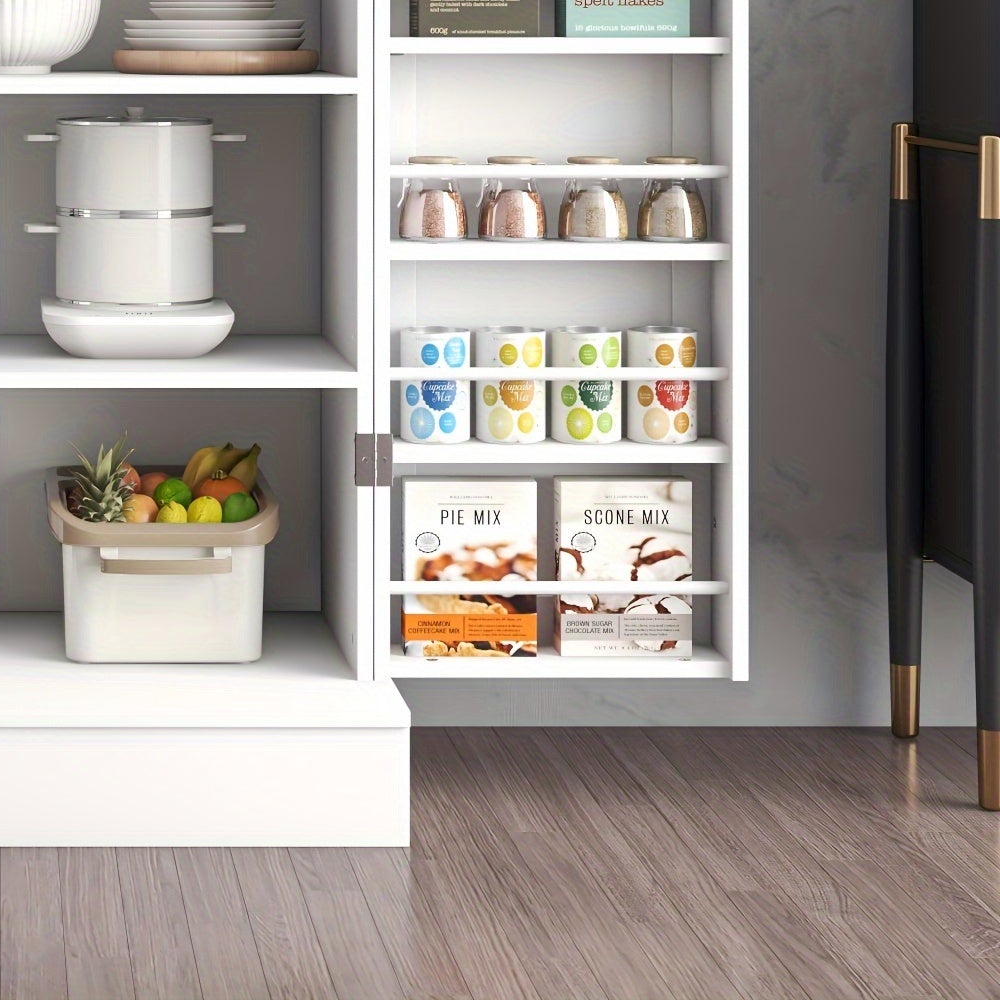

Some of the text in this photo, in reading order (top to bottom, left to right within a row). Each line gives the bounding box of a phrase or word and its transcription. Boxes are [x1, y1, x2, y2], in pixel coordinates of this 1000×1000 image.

[422, 383, 455, 394] Cupcake
[501, 383, 533, 394] Cupcake
[580, 383, 612, 394] Cupcake
[657, 383, 688, 394] Cupcake
[432, 391, 452, 402] Mix
[511, 391, 529, 402] Mix
[590, 391, 609, 402] Mix
[667, 391, 684, 402] Mix
[440, 510, 501, 525] PIE MIX
[584, 509, 670, 525] SCONE MIX
